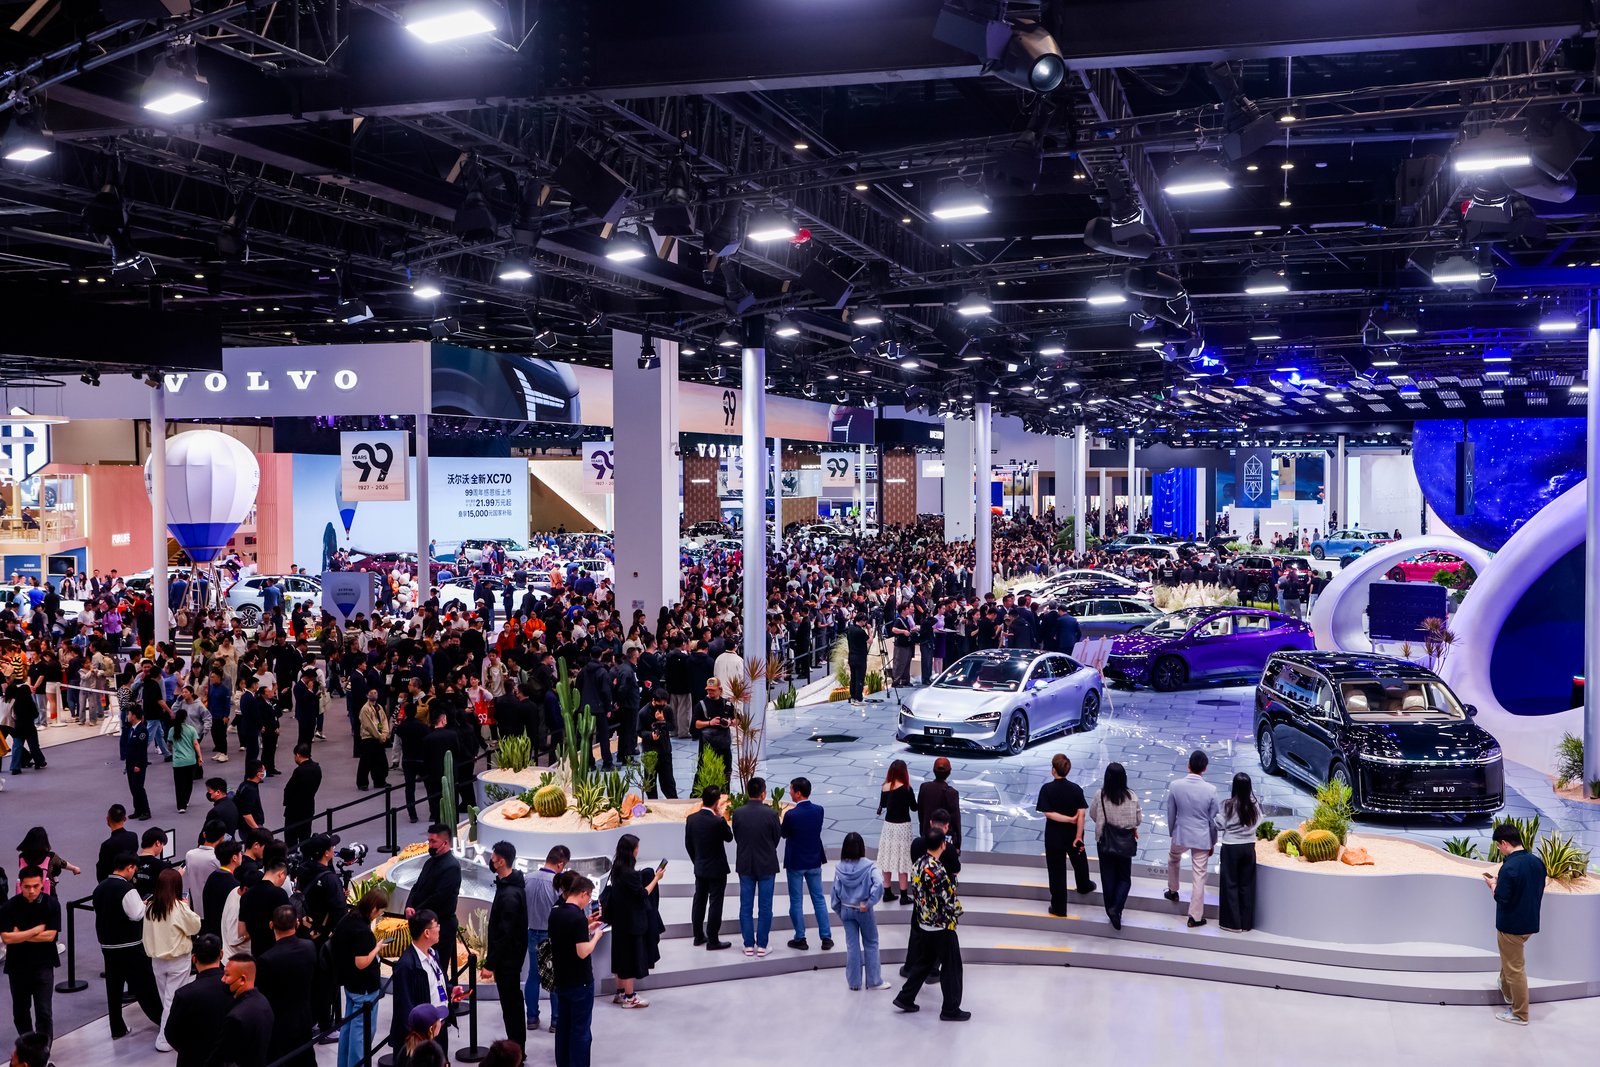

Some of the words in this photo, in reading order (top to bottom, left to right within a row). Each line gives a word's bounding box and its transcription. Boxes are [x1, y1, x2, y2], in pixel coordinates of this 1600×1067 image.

[164, 369, 358, 393] VOLVO
[723, 389, 736, 426] 99
[352, 442, 393, 482] 99
[826, 457, 849, 477] 99
